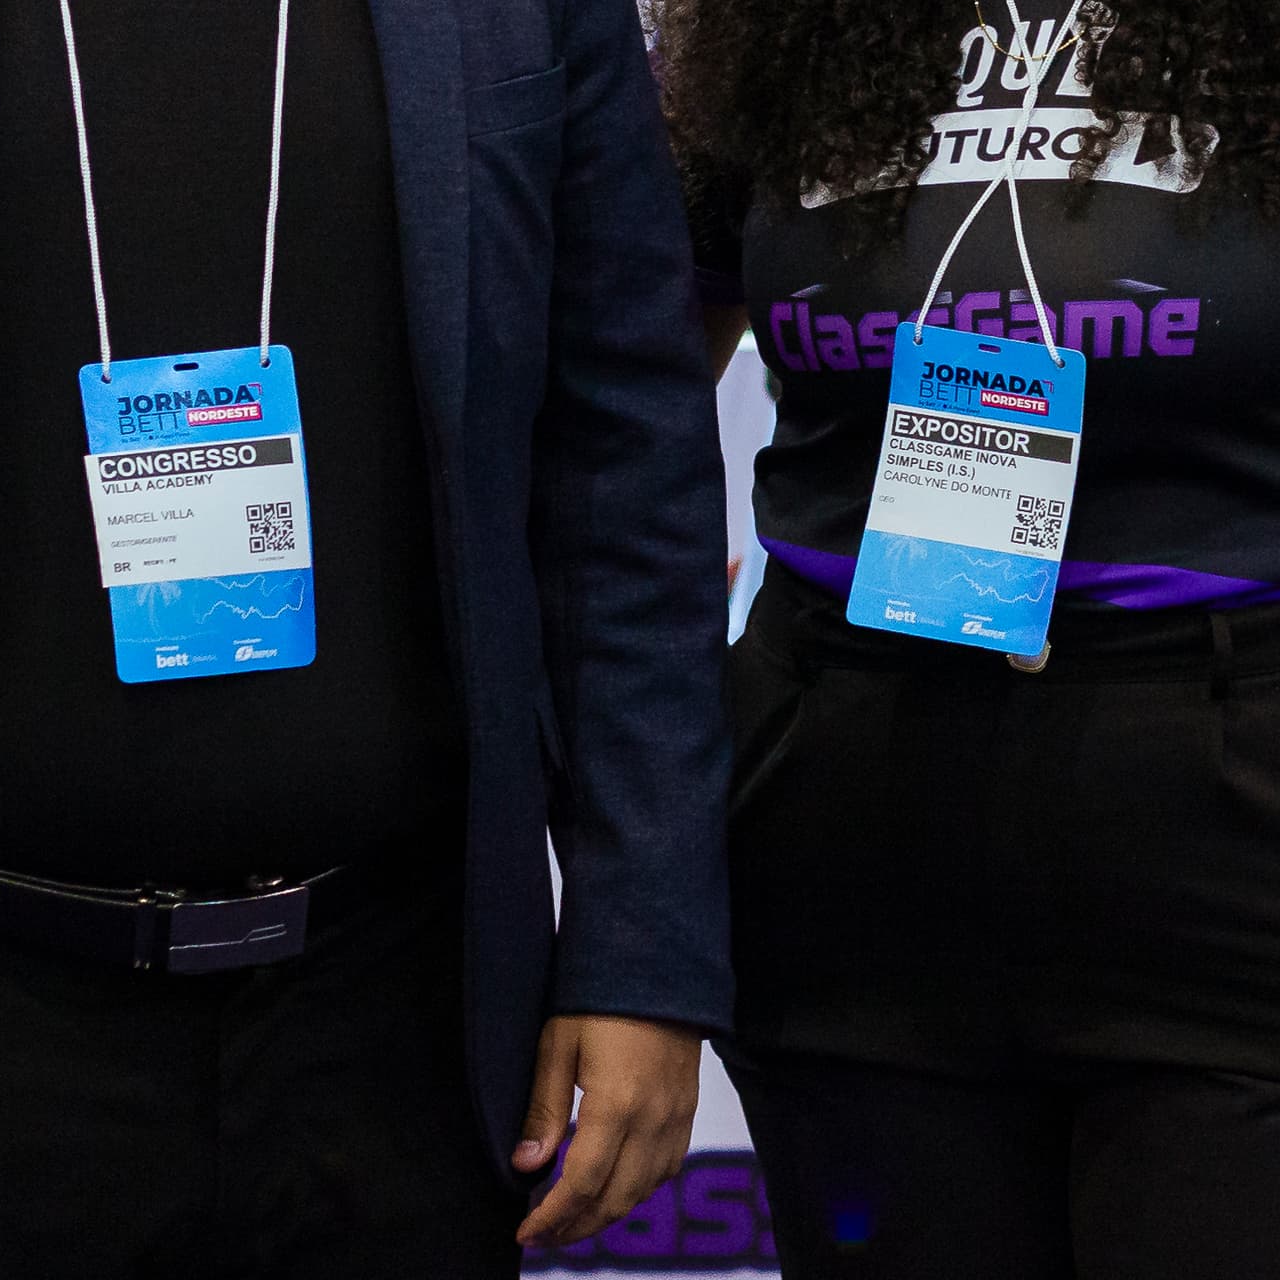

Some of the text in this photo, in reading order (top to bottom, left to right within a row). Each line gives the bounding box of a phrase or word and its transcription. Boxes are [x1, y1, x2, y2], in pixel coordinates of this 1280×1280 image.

[921, 362, 1045, 398] JORNADA
[117, 384, 255, 416] JORNADA
[919, 380, 977, 406] BETT
[982, 393, 1046, 411] NORDESTE
[119, 405, 258, 436] BETT NORDESTE
[894, 412, 1030, 453] EXPOSITOR
[100, 445, 257, 480] CONGRESSO
[886, 453, 977, 480] SIMPLES (I.S.)
[889, 438, 1017, 468] CLASSGAME INOVA
[102, 474, 214, 495] VILLA ACADEMY
[883, 470, 948, 490] CAROLYNE
[951, 480, 970, 493] DO
[107, 508, 195, 526] MARCEL VILLA
[114, 562, 131, 573] BR
